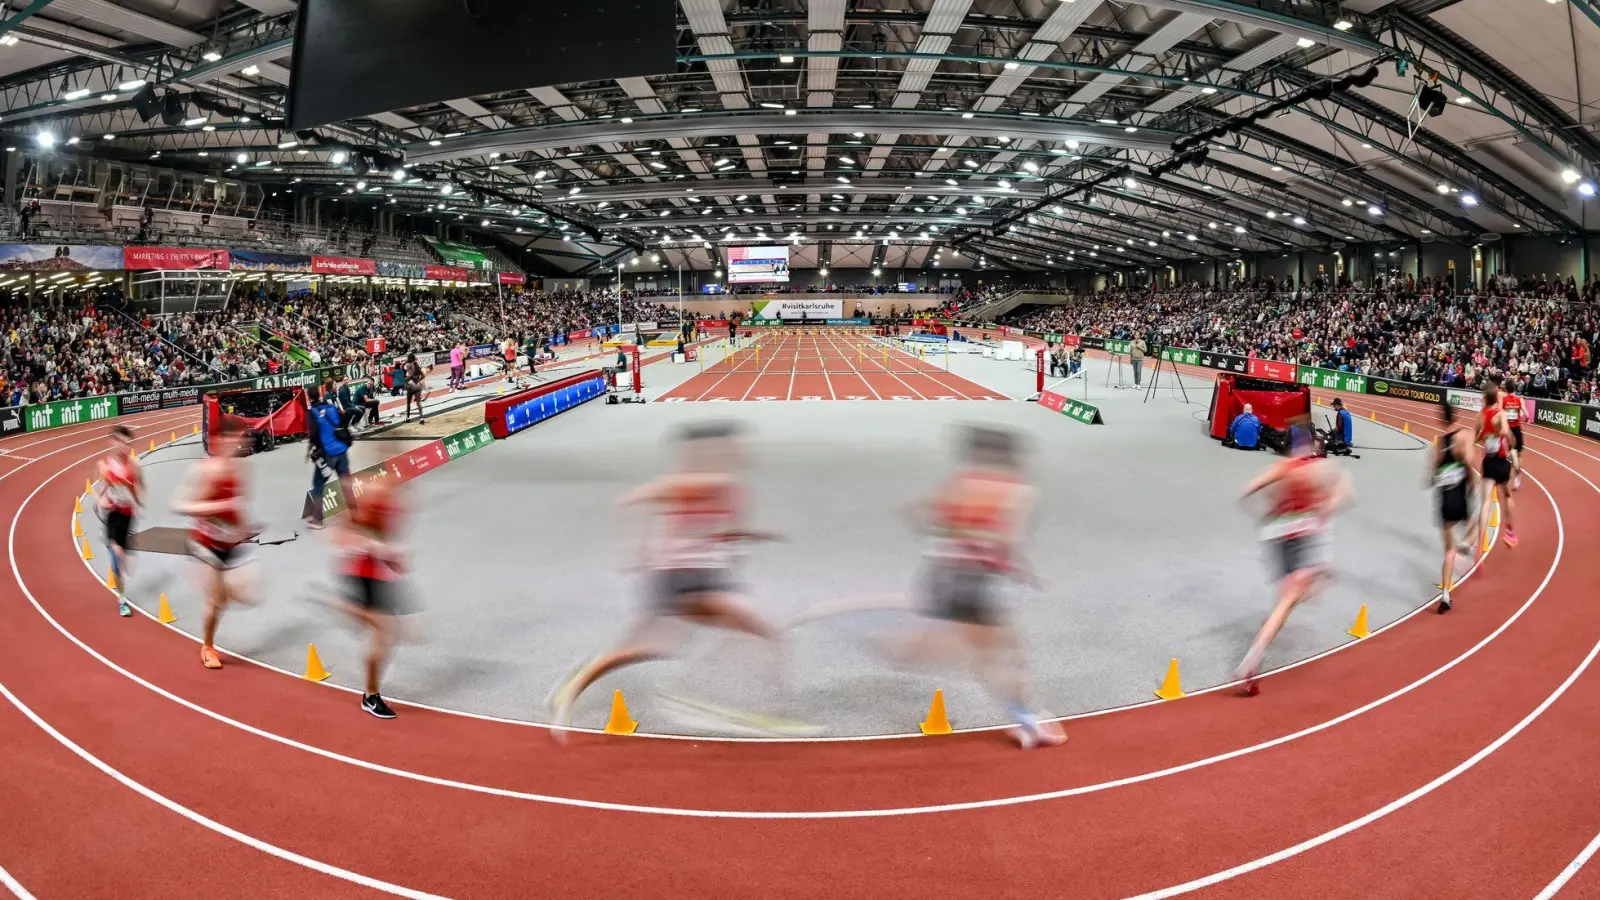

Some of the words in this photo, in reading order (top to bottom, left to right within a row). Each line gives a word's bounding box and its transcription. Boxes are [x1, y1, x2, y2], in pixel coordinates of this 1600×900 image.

[782, 302, 835, 310] #visitkarlsruhe
[373, 341, 380, 350] 6
[419, 355, 434, 366] SPORT
[1173, 350, 1184, 361] init
[1186, 352, 1197, 364] init
[282, 372, 316, 389] hoepfner
[1301, 369, 1318, 385] init
[1323, 372, 1340, 388] init
[1345, 375, 1364, 392] init
[122, 391, 160, 404] multi-media
[162, 388, 199, 400] multi-media
[1389, 386, 1410, 396] INDOOR
[1410, 389, 1425, 400] TOUR
[1424, 392, 1440, 402] GOLD
[32, 404, 54, 429] init
[61, 400, 83, 425] init
[90, 397, 112, 420] init
[1537, 408, 1577, 428] KARLSRUHE
[462, 432, 476, 449] init
[478, 426, 491, 443] init
[446, 438, 460, 457] init
[322, 488, 338, 512] nit
